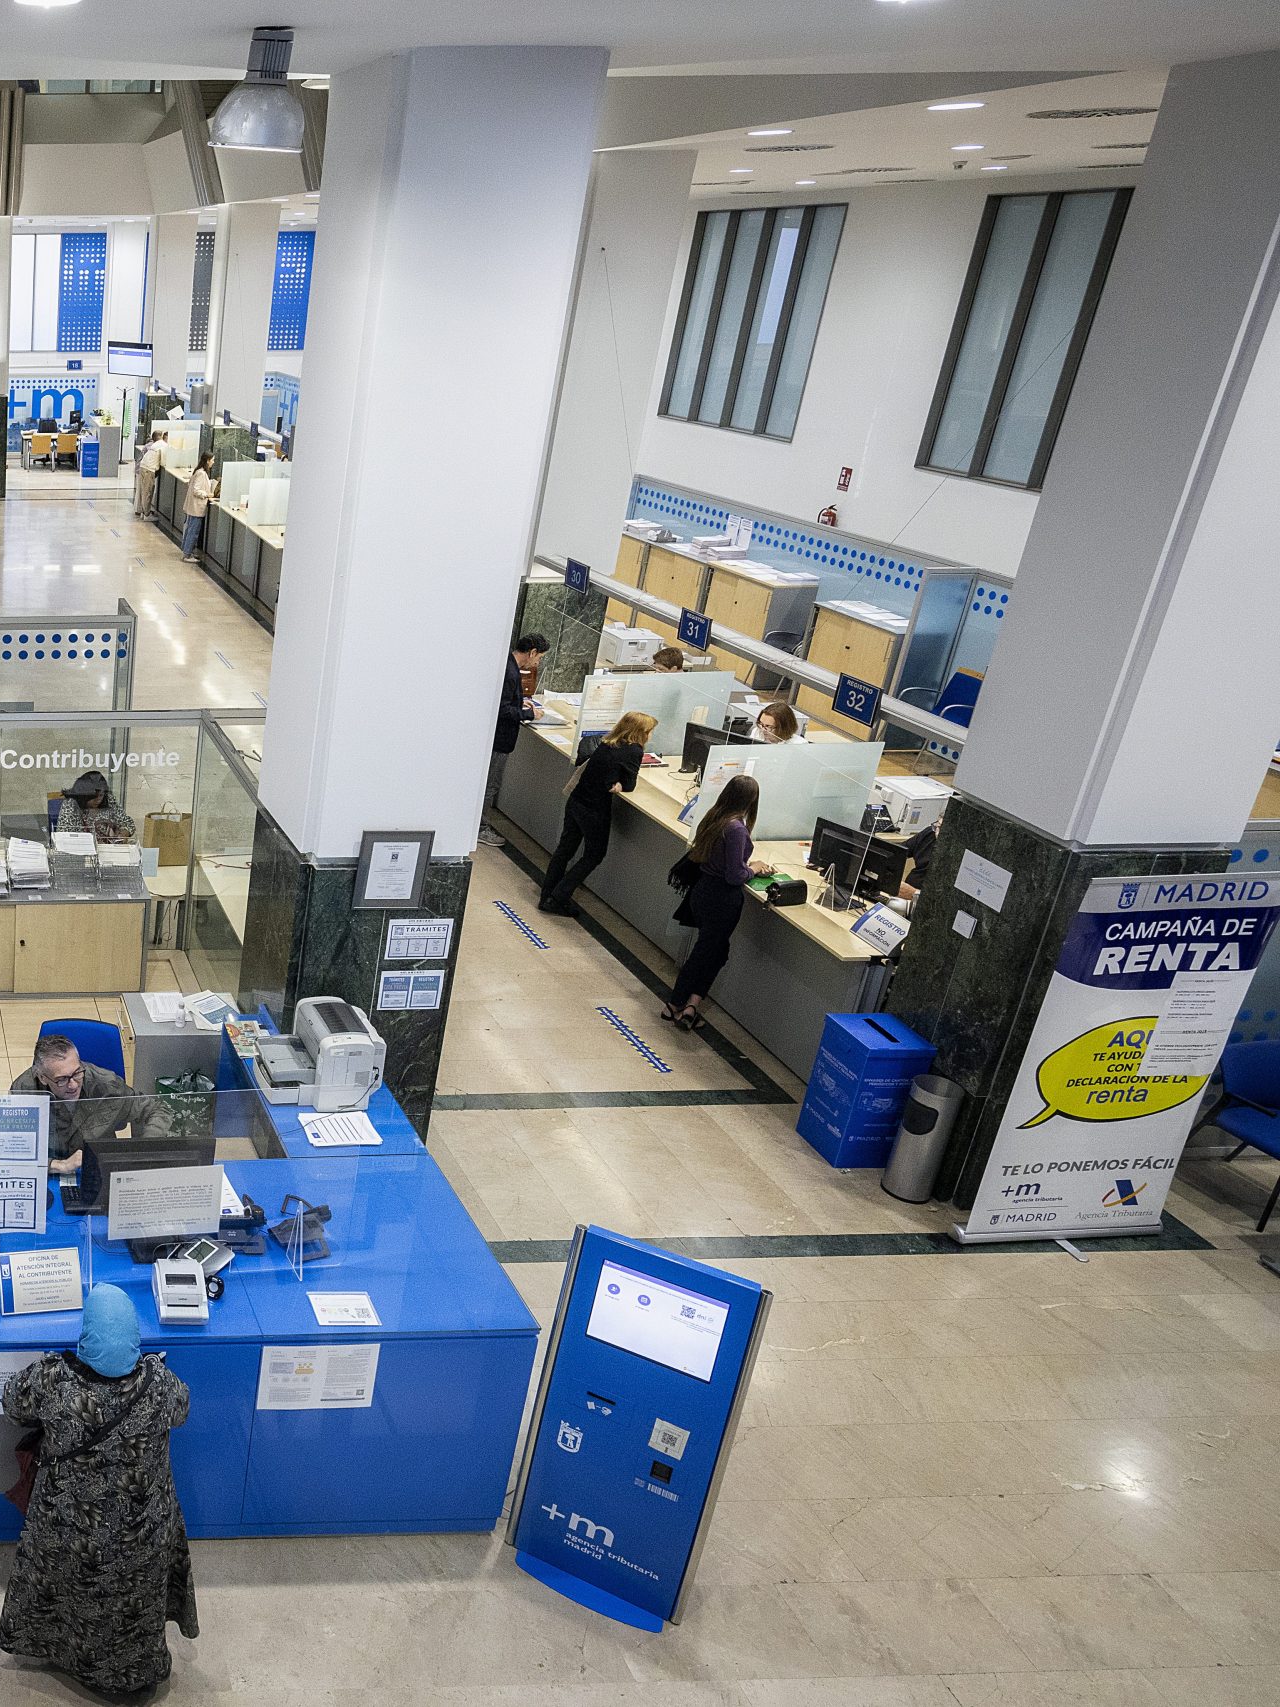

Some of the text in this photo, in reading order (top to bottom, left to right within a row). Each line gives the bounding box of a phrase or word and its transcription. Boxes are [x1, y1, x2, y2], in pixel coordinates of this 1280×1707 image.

[571, 569, 581, 585] 30
[686, 612, 706, 624] REGISTRO
[686, 621, 699, 639] 31
[847, 679, 873, 695] REGISTRO
[846, 690, 865, 712] 32
[0, 748, 180, 773] Contribuyente
[1153, 881, 1269, 904] MADRID
[874, 914, 906, 936] REGISTRO
[876, 927, 886, 936] NO
[1105, 916, 1257, 941] CAMPAÑA DE
[863, 928, 891, 947] INFORMACIÓN
[1092, 942, 1240, 976] RENTA
[1093, 1052, 1107, 1062] TE
[1107, 1050, 1145, 1061] AYUD
[1107, 1063, 1134, 1073] CON
[1152, 1075, 1171, 1084] DE
[1172, 1075, 1188, 1084] LA
[1085, 1085, 1149, 1105] renta
[1001, 1155, 1175, 1177] TE LO PONEMOS FÁCIL
[1001, 1182, 1041, 1198] +m
[1005, 1212, 1057, 1223] MADRID
[1075, 1210, 1153, 1220] Agencia Tributaria
[16, 1263, 44, 1271] ATENCIÓN
[27, 1269, 72, 1278] CONTRIBUYENTE
[541, 1503, 615, 1548] +m
[563, 1538, 602, 1561] madrid
[565, 1532, 660, 1581] agencia tributaria
